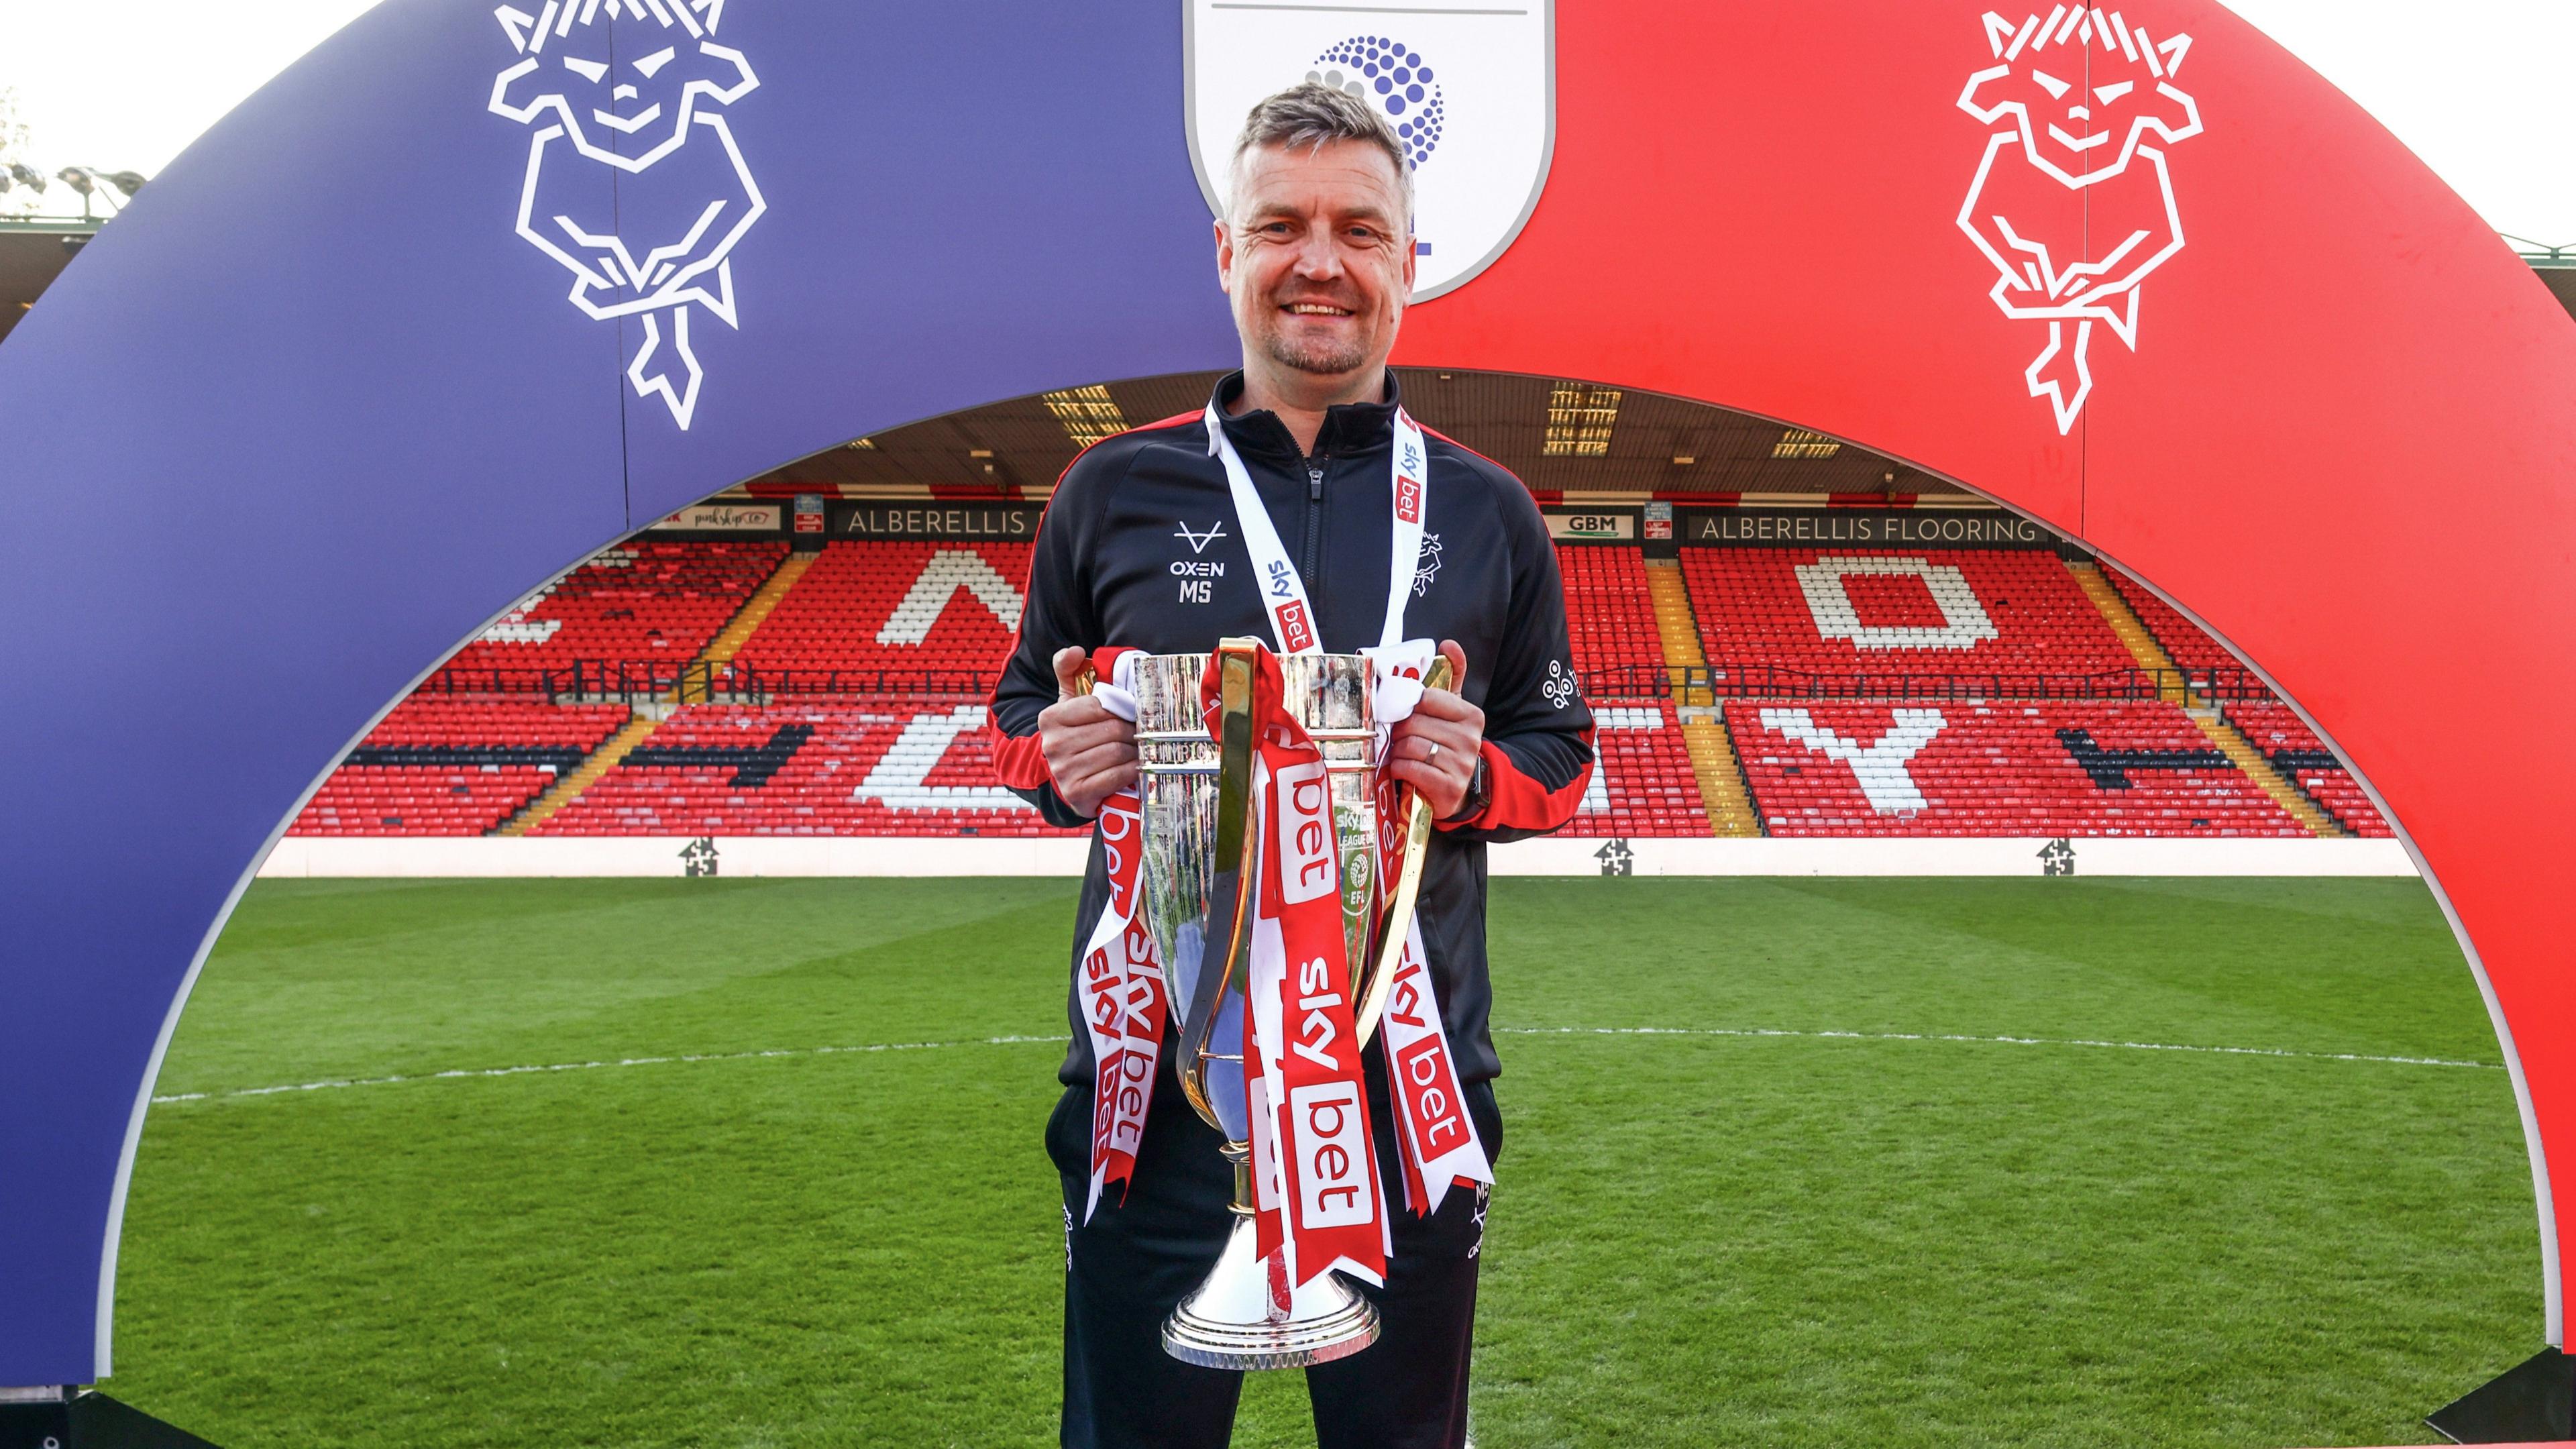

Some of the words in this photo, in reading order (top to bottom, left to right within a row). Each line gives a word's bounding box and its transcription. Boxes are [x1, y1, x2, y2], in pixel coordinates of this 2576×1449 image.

[1400, 442, 1421, 478] sky
[1399, 481, 1419, 519] bet
[848, 511, 1025, 533] ALBERELLIS
[1569, 516, 1616, 531] GBM
[1702, 517, 1871, 539] ALBERELLIS
[1886, 519, 2035, 541] FLOORING
[1169, 561, 1225, 577] OXEN
[1179, 580, 1212, 603] MS
[1267, 559, 1293, 597] sky
[1282, 604, 1308, 647] bet
[1292, 773, 1329, 888] bet
[1336, 811, 1358, 830] sky
[1338, 834, 1366, 847] LEAGUE
[1350, 890, 1365, 905] EFL
[1085, 947, 1122, 1041] sky
[1128, 932, 1164, 1033] sky
[1292, 957, 1342, 1071] sky
[1096, 1061, 1121, 1159] bet
[1117, 1049, 1154, 1143] bet
[1409, 1046, 1456, 1147] bet
[1309, 1097, 1359, 1212] bet
